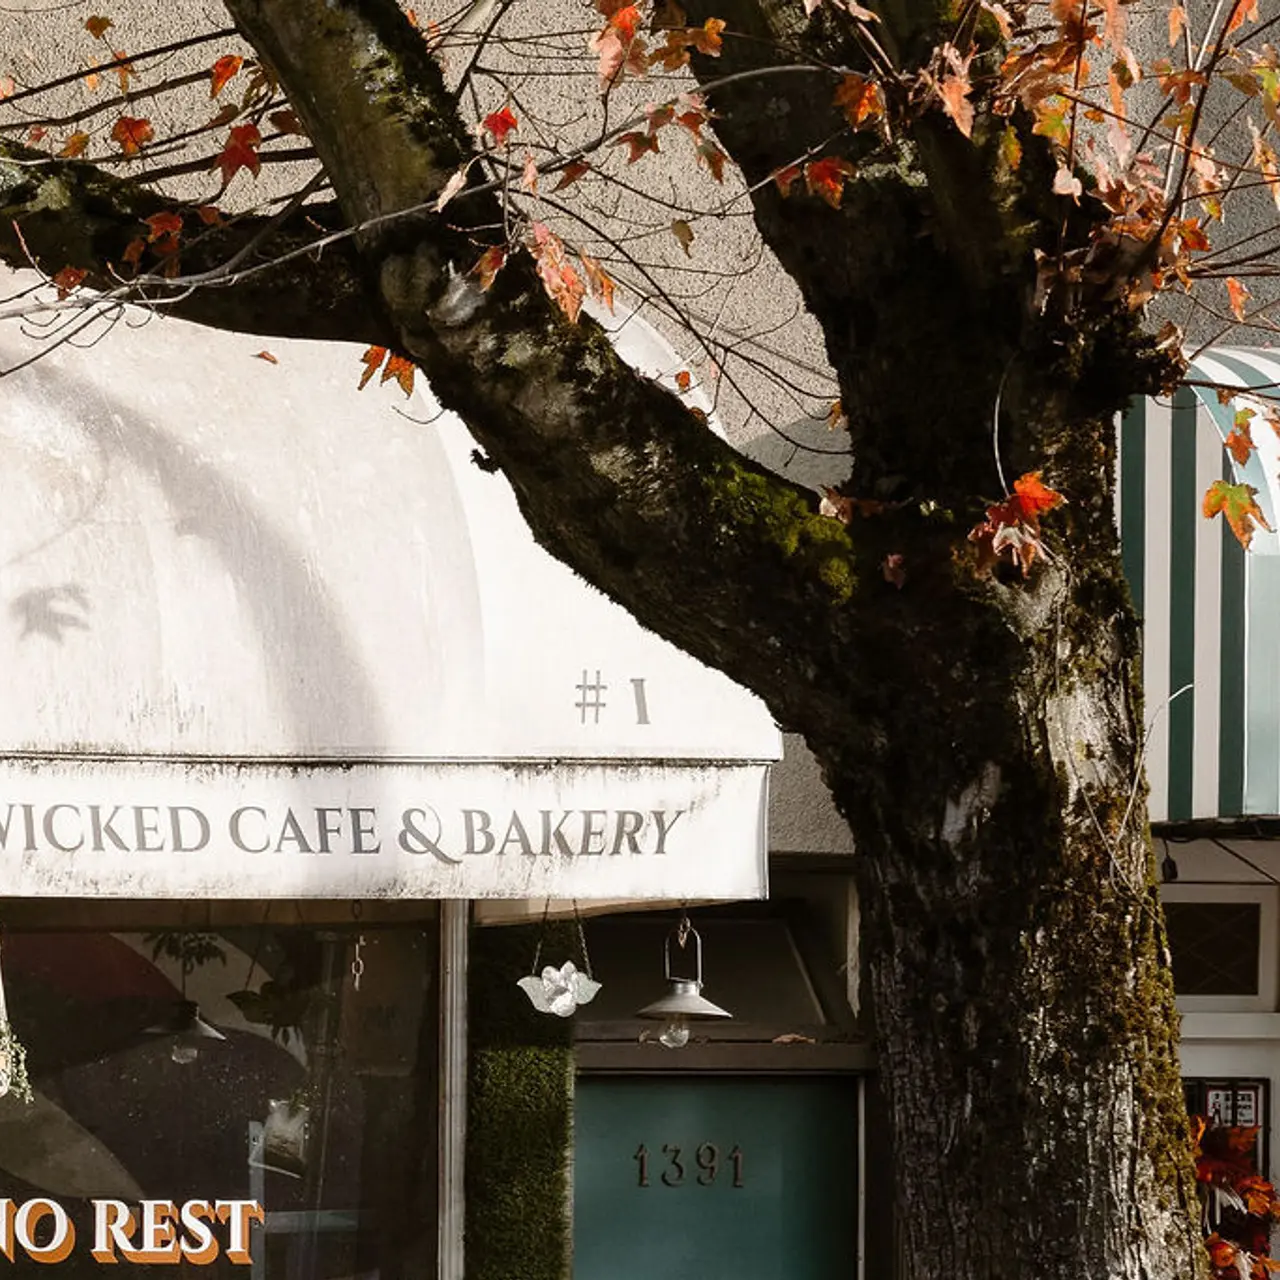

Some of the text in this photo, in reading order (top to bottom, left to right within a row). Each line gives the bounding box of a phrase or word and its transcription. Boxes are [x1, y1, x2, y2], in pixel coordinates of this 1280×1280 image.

[229, 803, 381, 855] CAFE
[397, 803, 462, 865] &
[462, 805, 687, 857] BAKERY
[633, 1142, 746, 1188] 1391
[90, 1198, 266, 1266] REST
